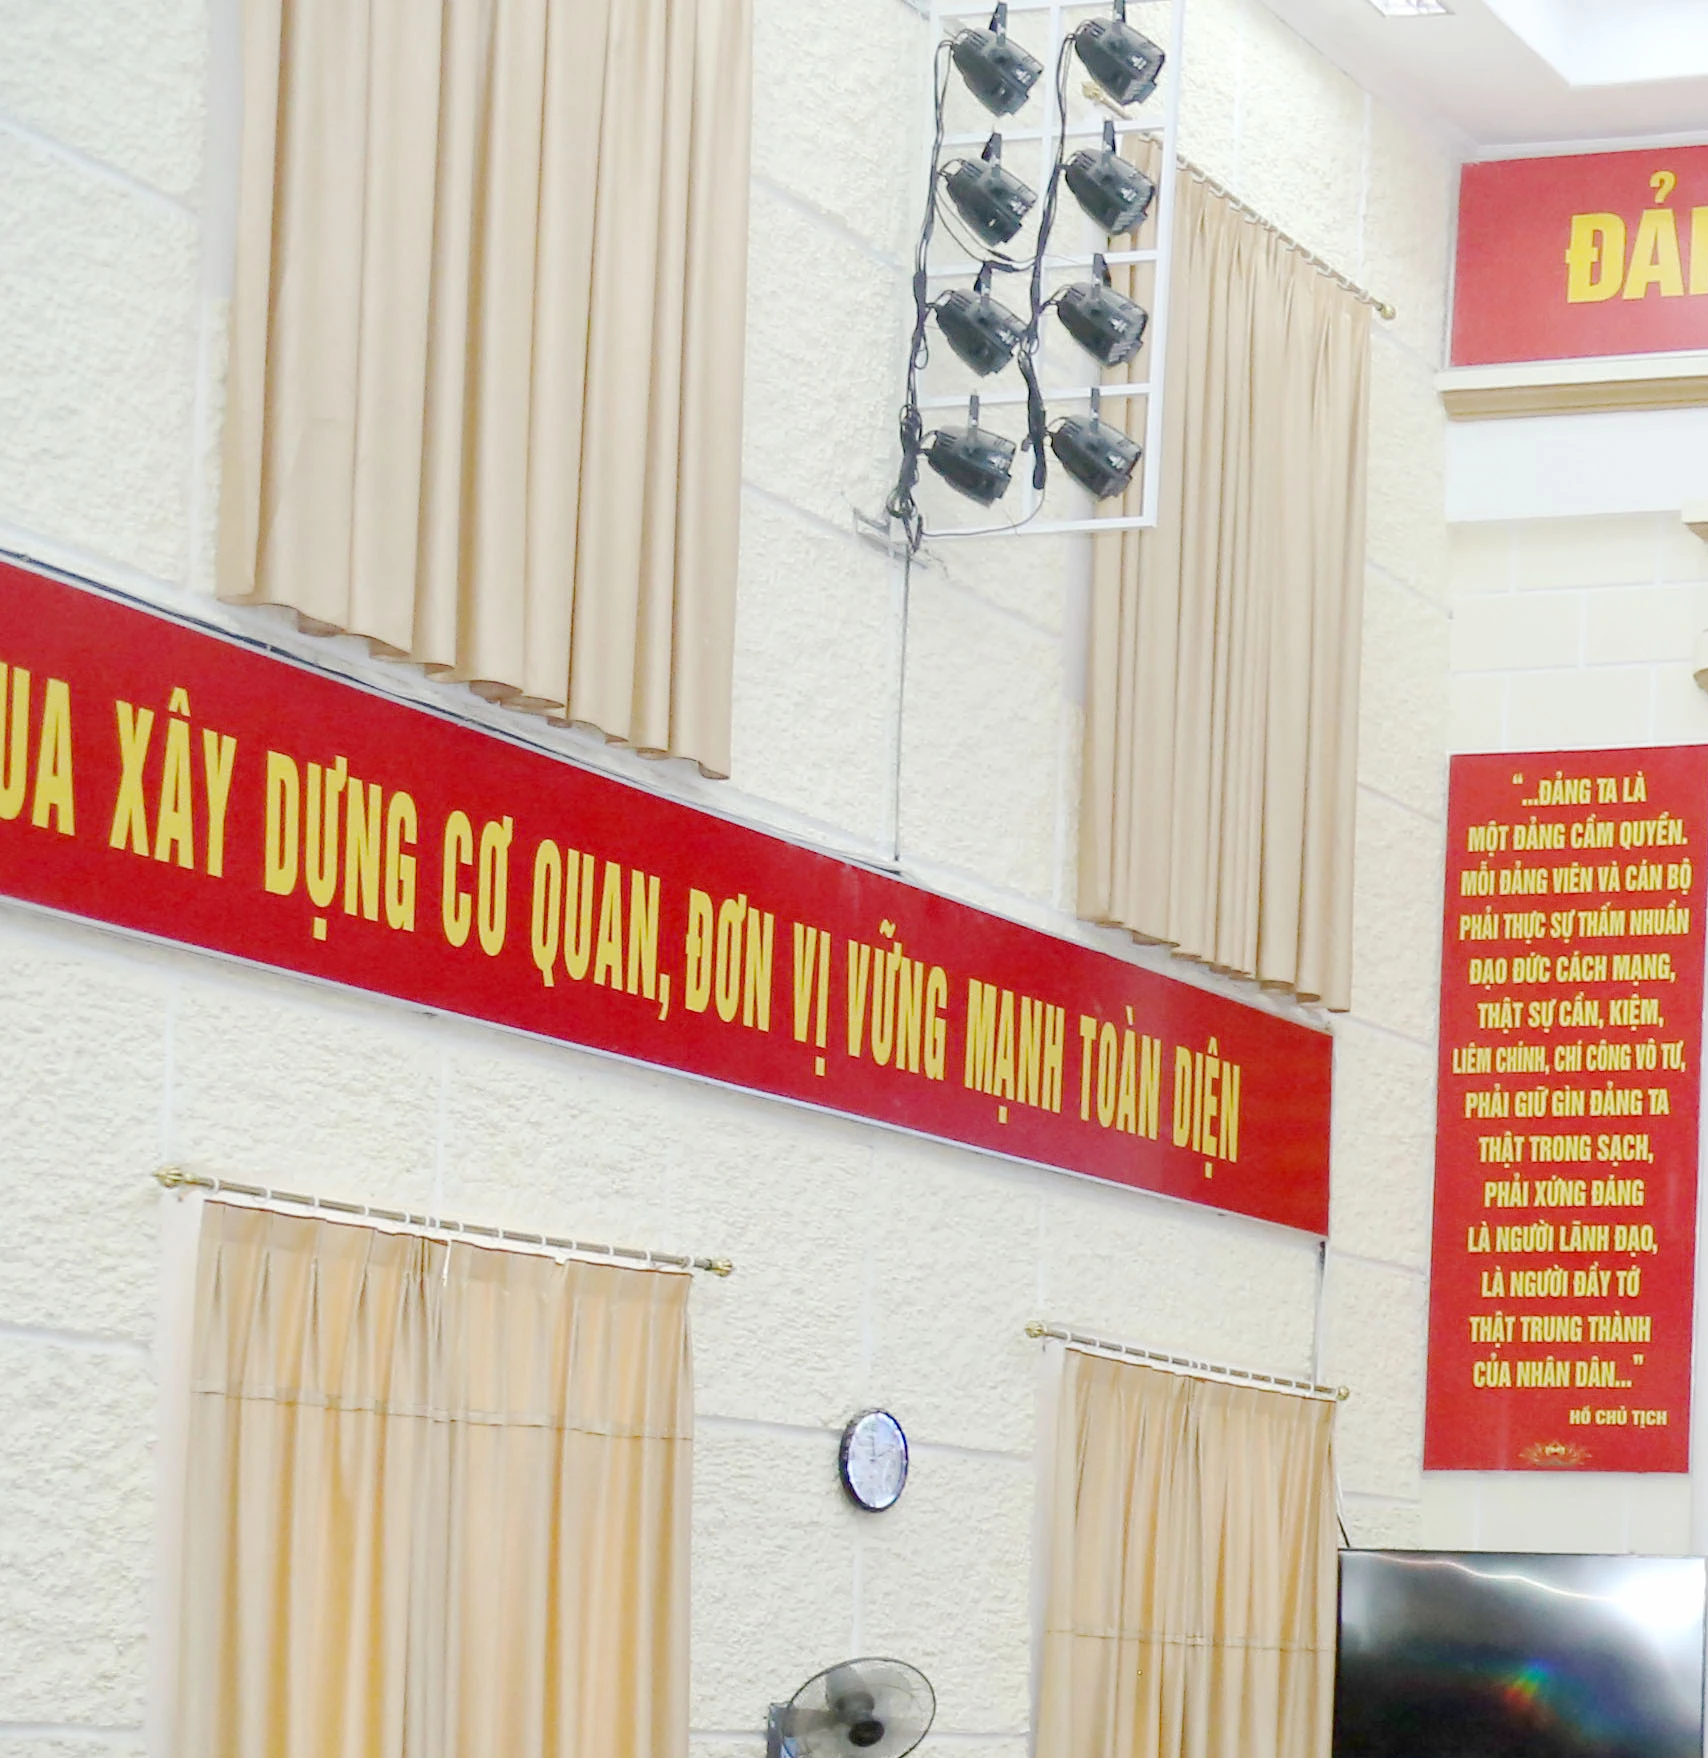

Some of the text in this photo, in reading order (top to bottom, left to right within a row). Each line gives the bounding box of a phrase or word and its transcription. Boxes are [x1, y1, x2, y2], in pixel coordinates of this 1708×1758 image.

[1499, 860, 1548, 895] ĐẢNG
[1552, 862, 1593, 893] VIÊN
[1597, 861, 1620, 892] VÀ
[1625, 859, 1663, 891] CÁN
[1667, 858, 1692, 895] BỘ
[110, 687, 237, 877] XÂY
[265, 751, 417, 940] DỰNG
[442, 811, 513, 956] CƠ
[531, 839, 670, 1020] QUAN,
[685, 888, 774, 1032] ĐƠN
[794, 922, 830, 1076] VỊ
[848, 919, 947, 1080] VỮNG
[965, 979, 1064, 1123] MẠNH
[1080, 1006, 1161, 1140] TOÀN
[1173, 1037, 1240, 1178] DIỆN
[1469, 951, 1676, 990] ĐẠO ĐỨC CÁCH MẠNG,
[1453, 1038, 1686, 1074] LIÊM CHÍNH, CHÍ CÔNG VÔ TƯ,
[1465, 1081, 1669, 1118] PHẢI GIỮ GÌN ĐẢNG TA
[1479, 1131, 1654, 1168] THẬT TRONG SẠCH,
[1484, 1172, 1644, 1207] PHẢI XỨNG ĐÁNG
[1468, 1219, 1658, 1257] LÀ NGƯỜI LÃNH ĐẠO,
[1469, 1310, 1651, 1348] THẬT TRUNG THÀNH
[1595, 1406, 1627, 1425] CHỦ
[1631, 1410, 1667, 1428] TỊCH
